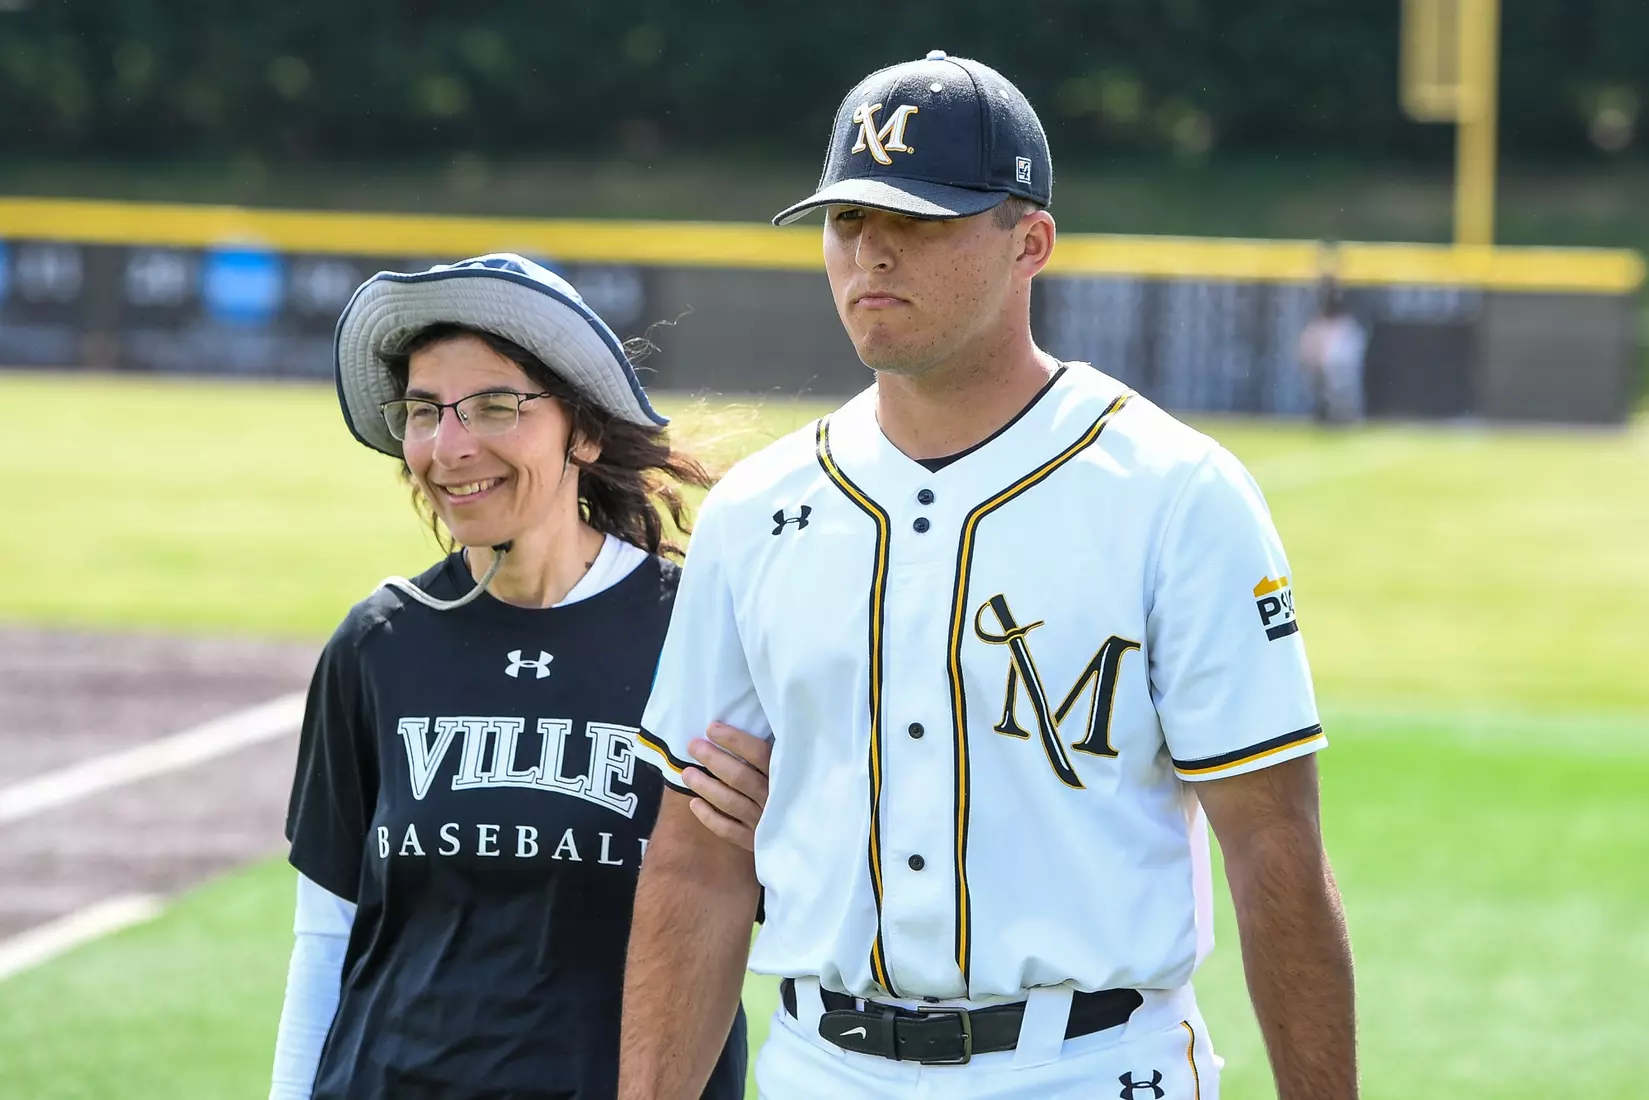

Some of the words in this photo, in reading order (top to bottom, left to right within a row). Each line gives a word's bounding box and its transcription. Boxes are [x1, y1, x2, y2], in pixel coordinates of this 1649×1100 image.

[852, 102, 918, 165] M
[974, 593, 1141, 789] M
[397, 716, 641, 819] VILLE
